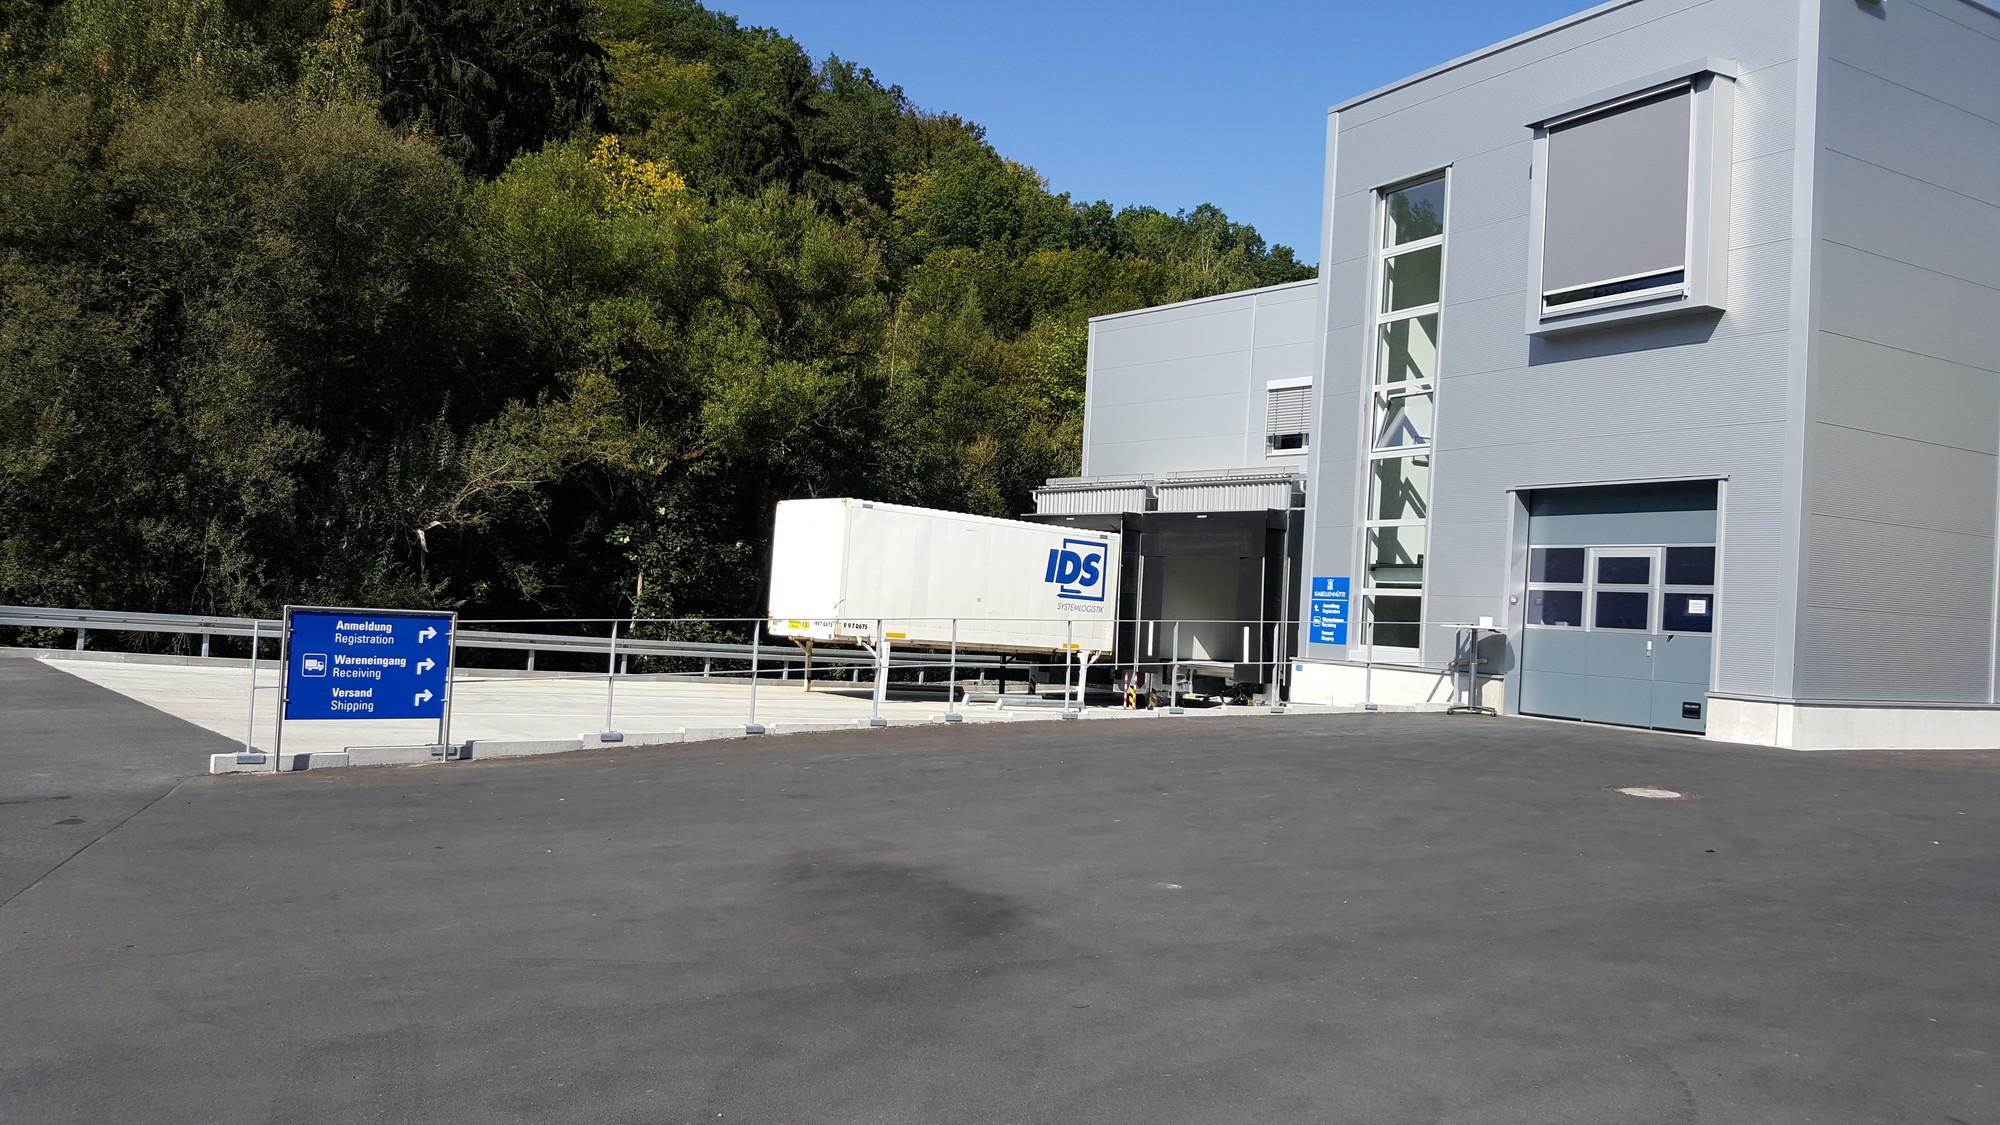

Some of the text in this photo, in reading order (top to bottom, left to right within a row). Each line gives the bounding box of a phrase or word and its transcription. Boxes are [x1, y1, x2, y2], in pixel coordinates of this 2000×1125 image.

[1045, 548, 1102, 587] IDS
[1057, 602, 1104, 613] SYSTEMLOGISTIK
[336, 620, 392, 633] Anmeldung
[335, 633, 394, 645] Registration
[334, 655, 407, 668] Wareneingang
[332, 668, 381, 680] Receiving
[332, 688, 373, 698] Versand
[331, 700, 374, 712] Shipping
